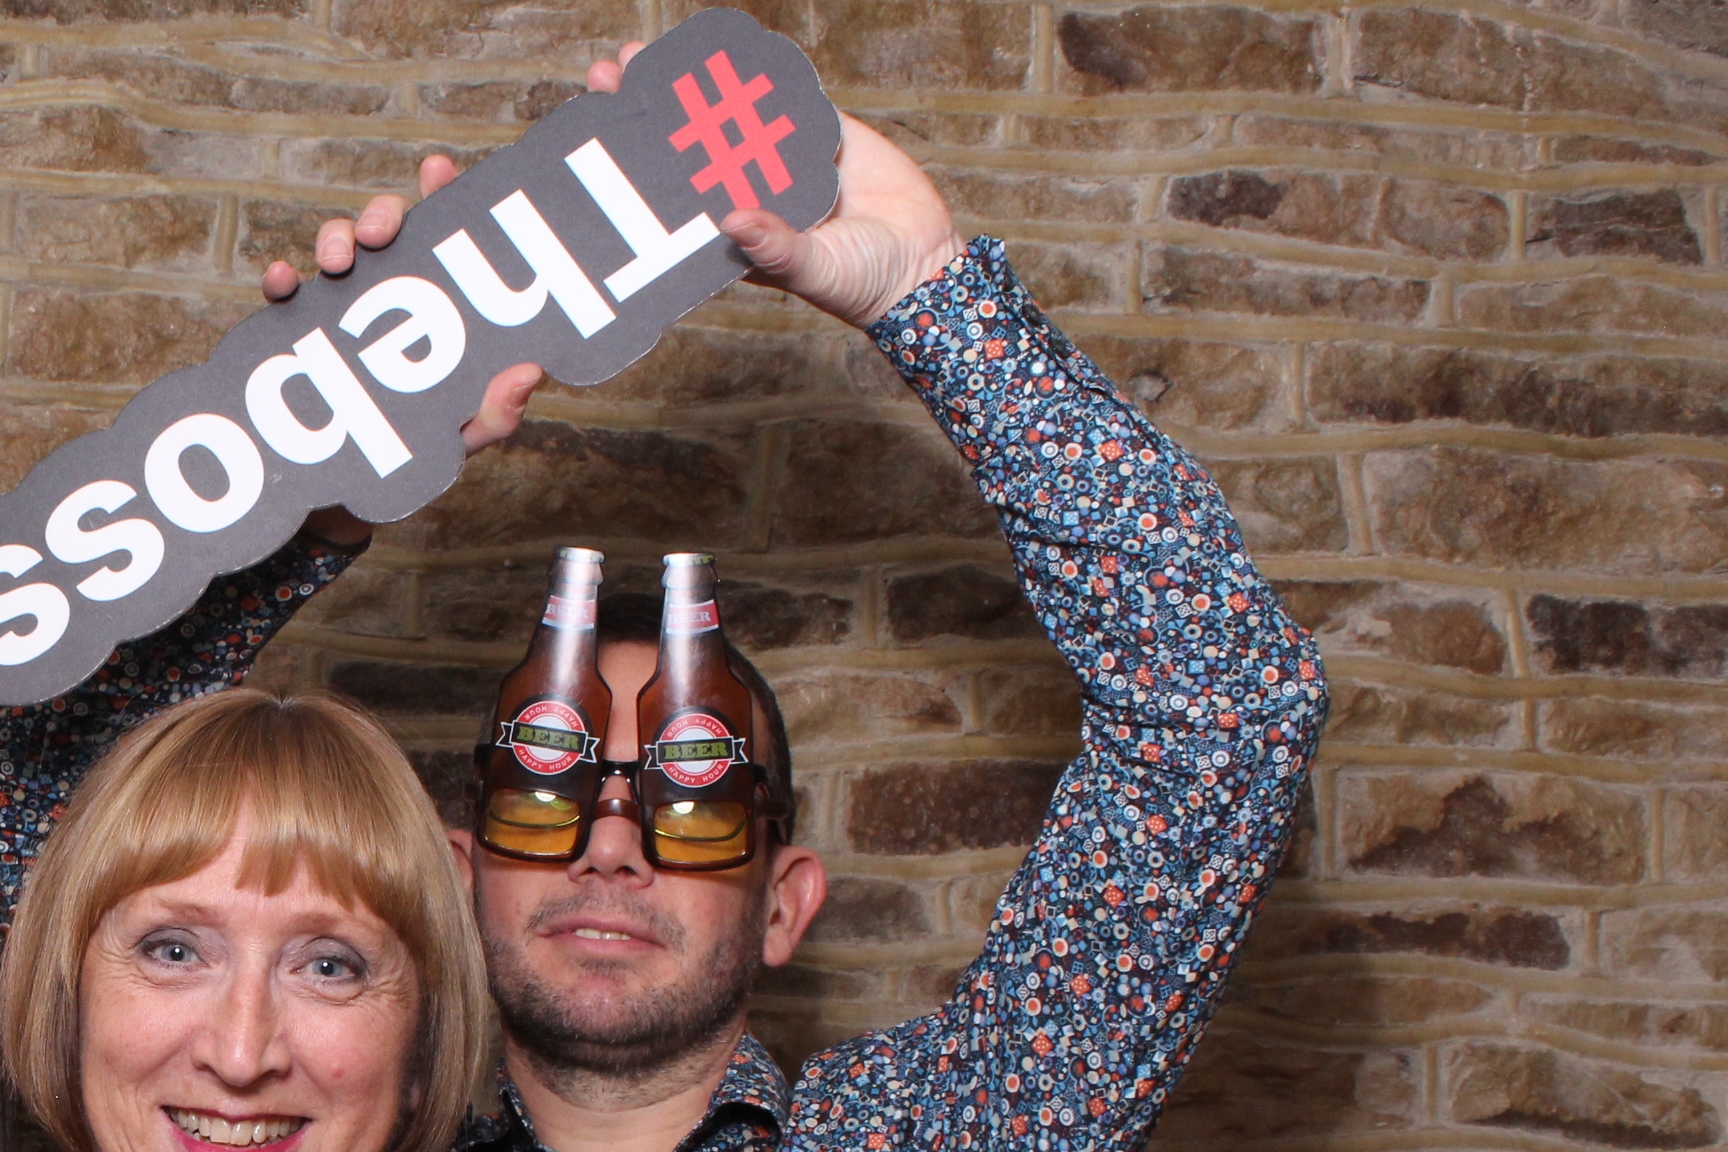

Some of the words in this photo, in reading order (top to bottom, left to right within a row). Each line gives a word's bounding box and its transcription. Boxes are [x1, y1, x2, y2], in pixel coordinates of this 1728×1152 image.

[546, 603, 588, 619] BEER
[667, 611, 712, 624] BEER
[524, 705, 548, 720] HOUR
[554, 706, 578, 728] HAPPY
[667, 720, 688, 738] HOUR
[695, 719, 722, 735] HAPPY
[517, 726, 579, 750] BEER
[518, 749, 543, 769] HAPPY
[549, 755, 572, 771] HOUR
[664, 742, 728, 760] BEER
[668, 766, 696, 783] HAPPY
[702, 764, 724, 782] HOUR
